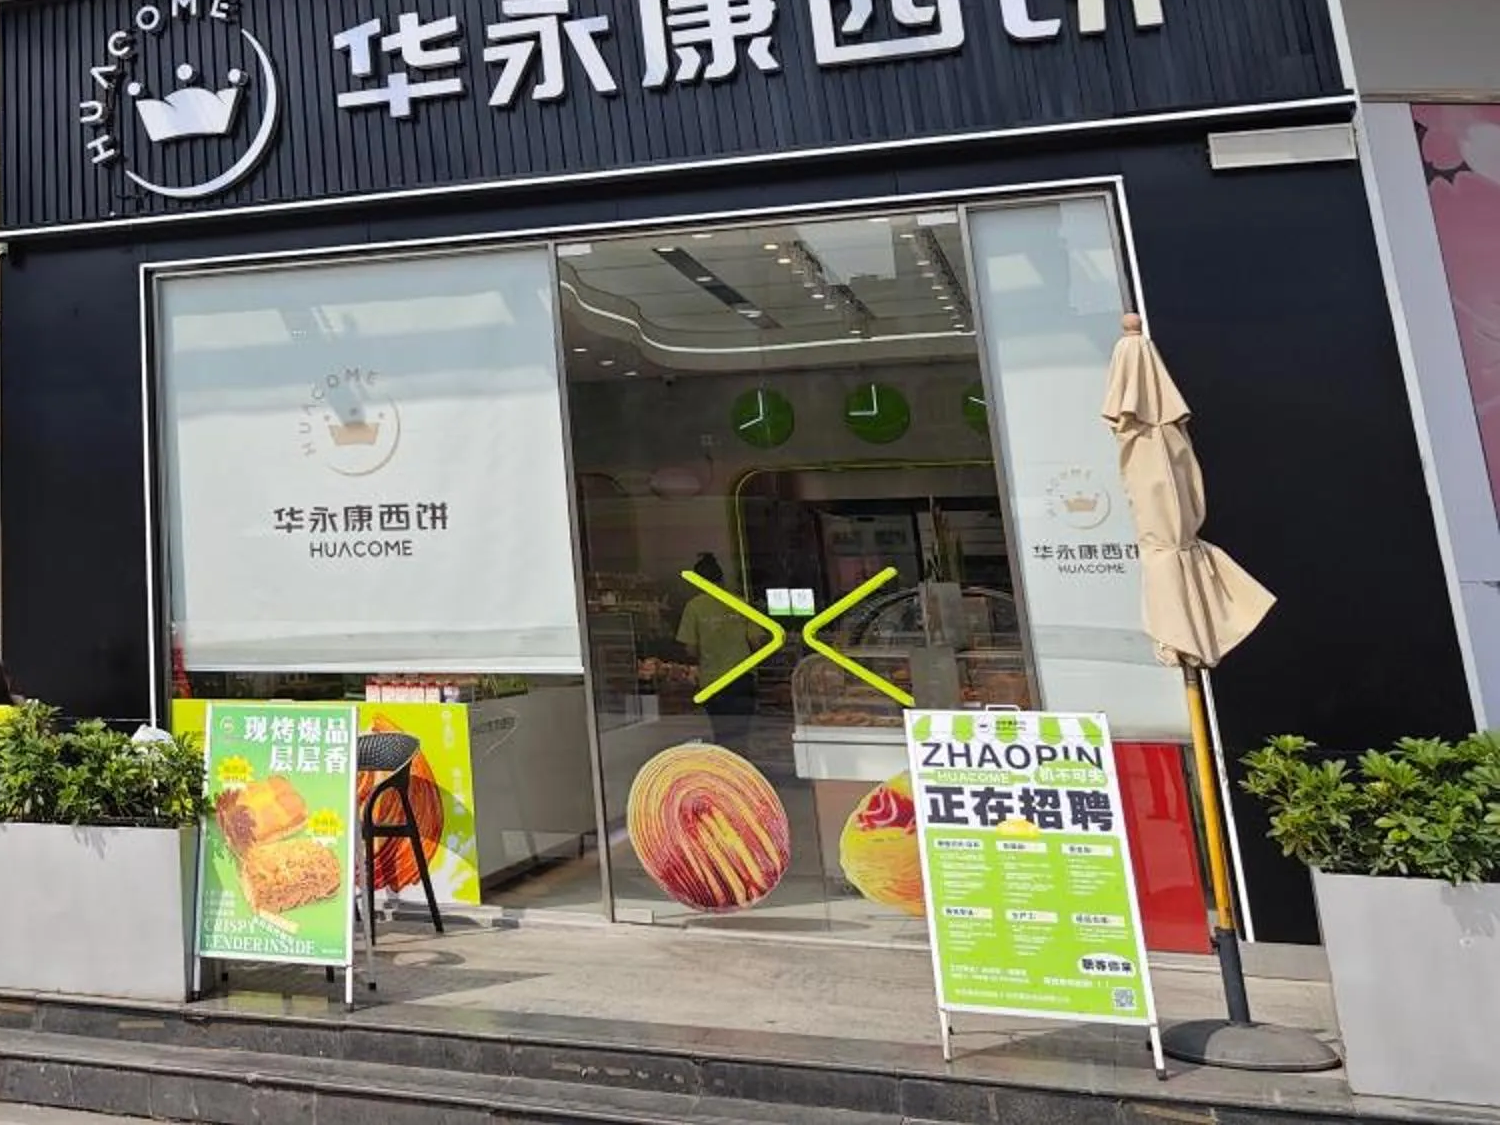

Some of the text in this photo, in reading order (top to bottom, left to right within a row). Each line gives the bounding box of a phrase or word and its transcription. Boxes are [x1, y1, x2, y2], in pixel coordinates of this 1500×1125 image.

[274, 502, 449, 534] 华永康西饼
[310, 540, 413, 558] HUACOME
[243, 715, 349, 744] 现烤爆品
[269, 745, 349, 774] 层层香
[920, 742, 1103, 770] ZHAOPIN
[924, 785, 1114, 833] 正在招聘
